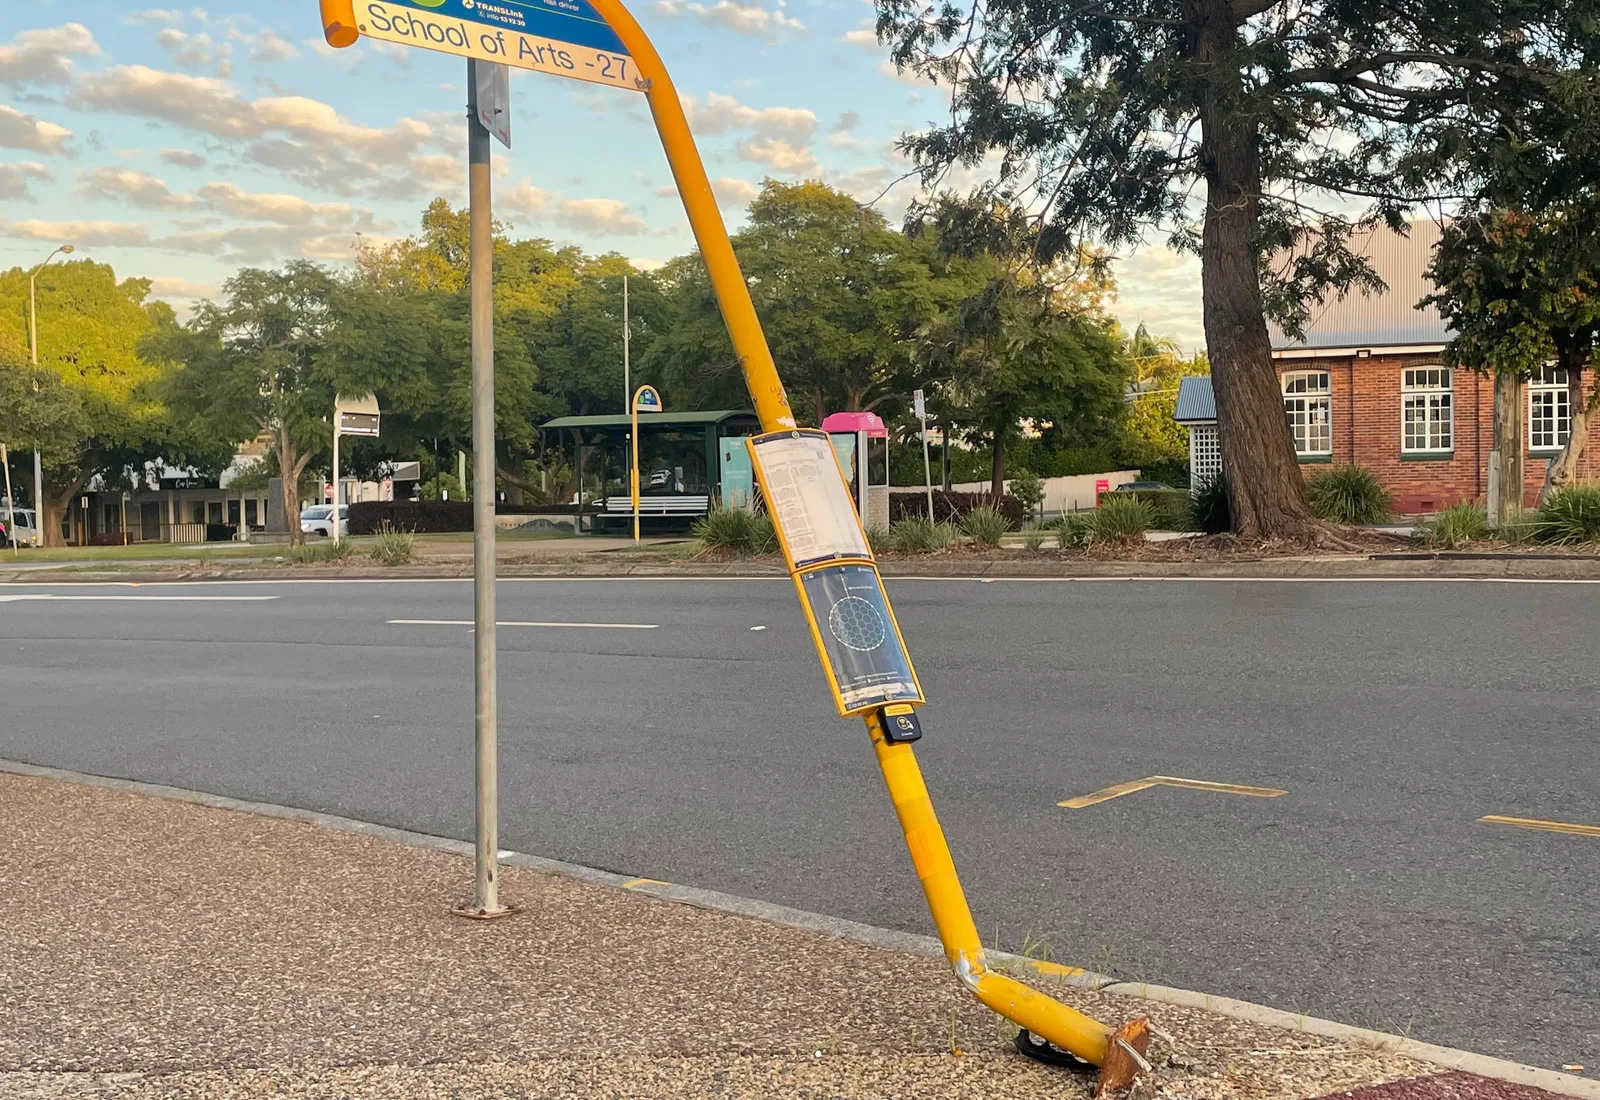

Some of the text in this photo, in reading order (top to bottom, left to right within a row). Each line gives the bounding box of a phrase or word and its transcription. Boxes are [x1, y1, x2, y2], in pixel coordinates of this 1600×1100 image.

[367, 3, 627, 81] School of Arts -27
